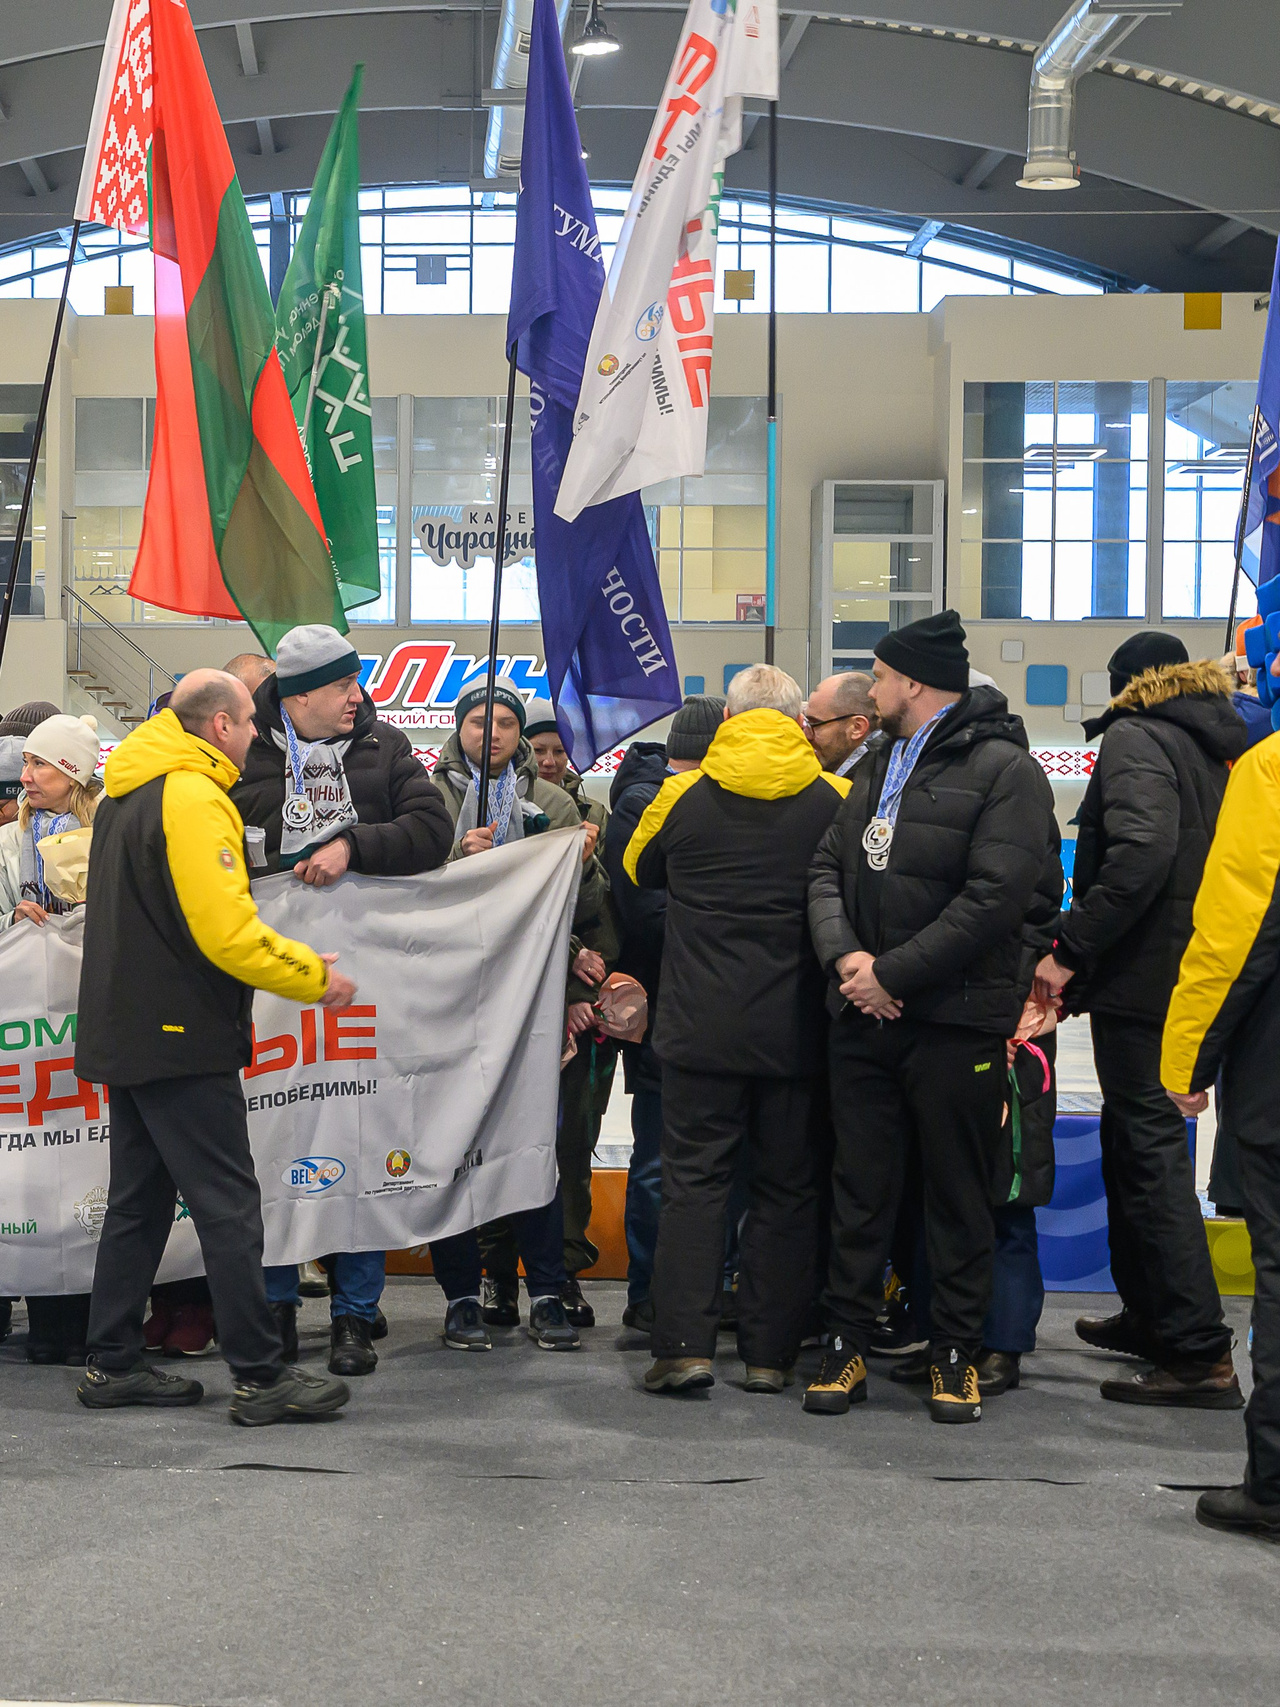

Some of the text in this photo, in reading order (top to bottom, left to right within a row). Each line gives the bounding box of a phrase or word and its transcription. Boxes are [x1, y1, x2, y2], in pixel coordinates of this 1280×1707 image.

[599, 567, 668, 677] НОСТИ
[43, 1129, 81, 1147] МЫ
[248, 1078, 377, 1113] ЕПОБЕДИМЫ!
